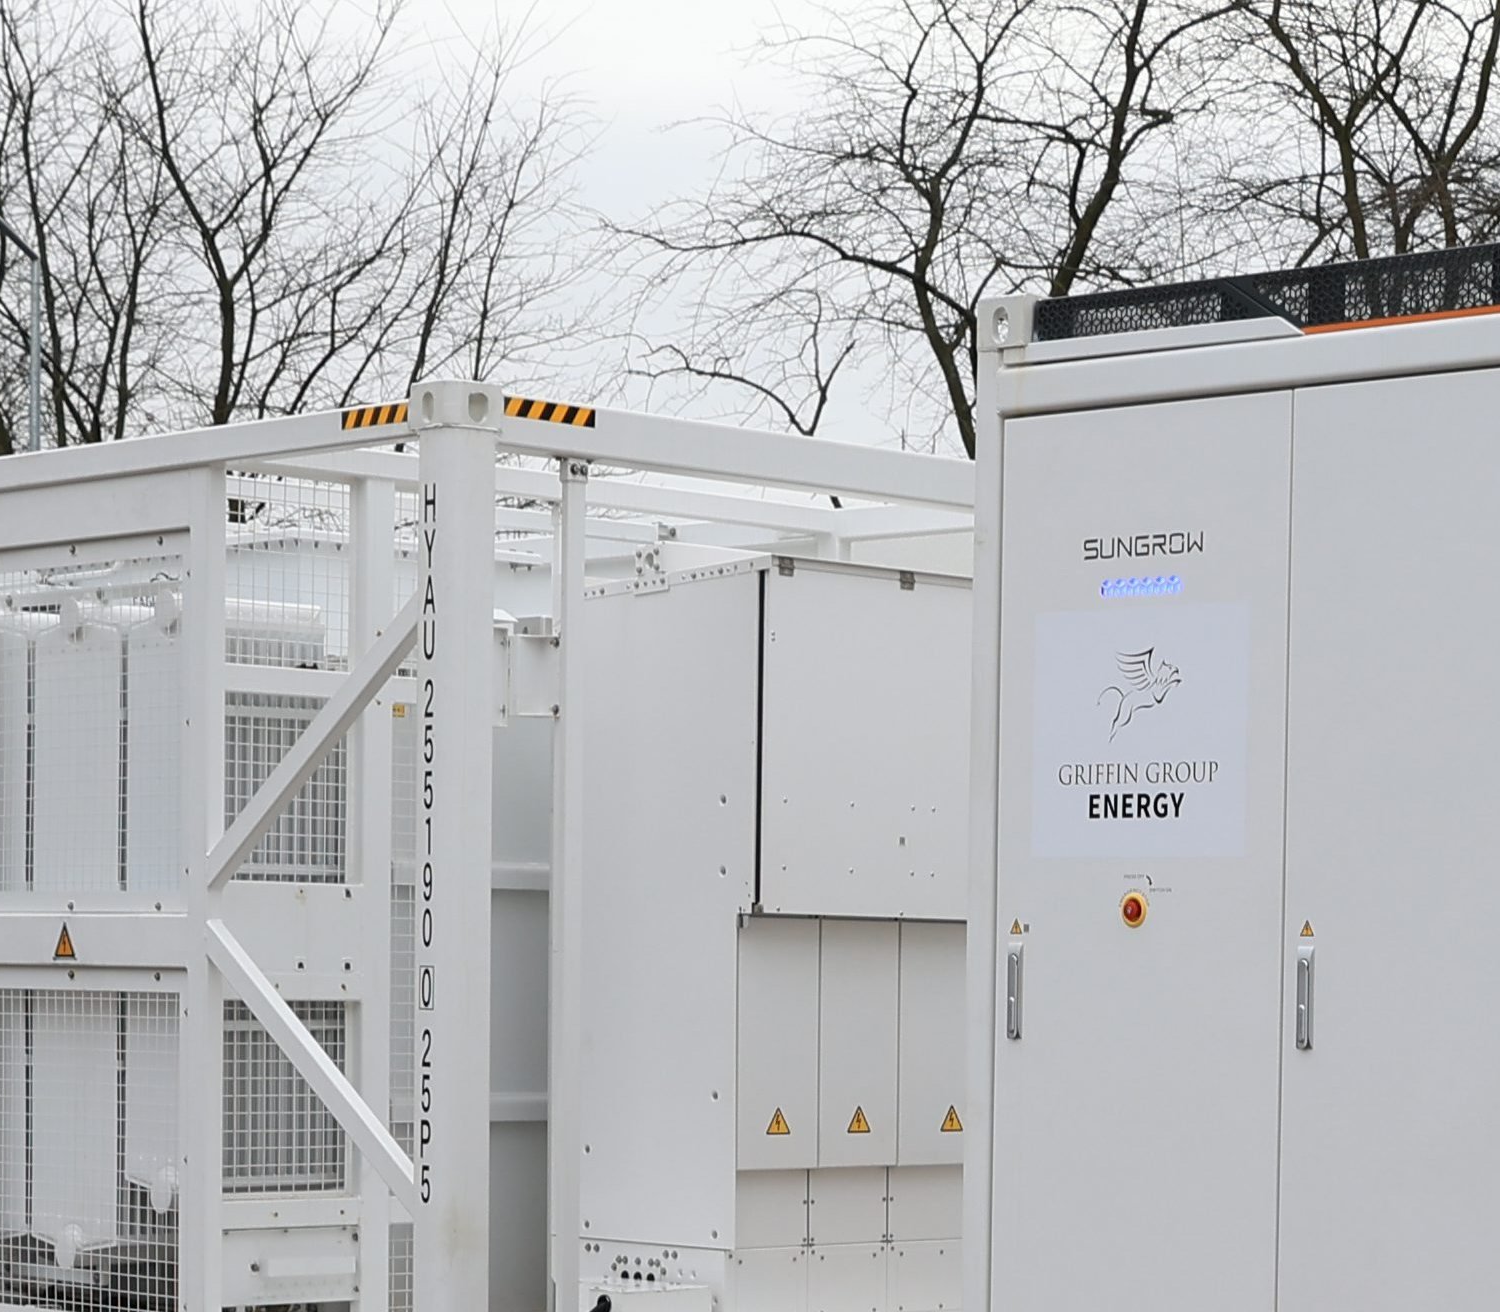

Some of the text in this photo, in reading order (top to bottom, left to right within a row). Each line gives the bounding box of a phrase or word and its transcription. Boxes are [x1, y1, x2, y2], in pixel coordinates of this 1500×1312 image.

[422, 482, 437, 661] HYAU
[1083, 531, 1204, 561] SUNGROW
[421, 679, 435, 948] 255190
[1058, 760, 1219, 787] GRIFFIN GROUP
[1088, 792, 1185, 820] ENERGY
[419, 1028, 433, 1205] 25P5
